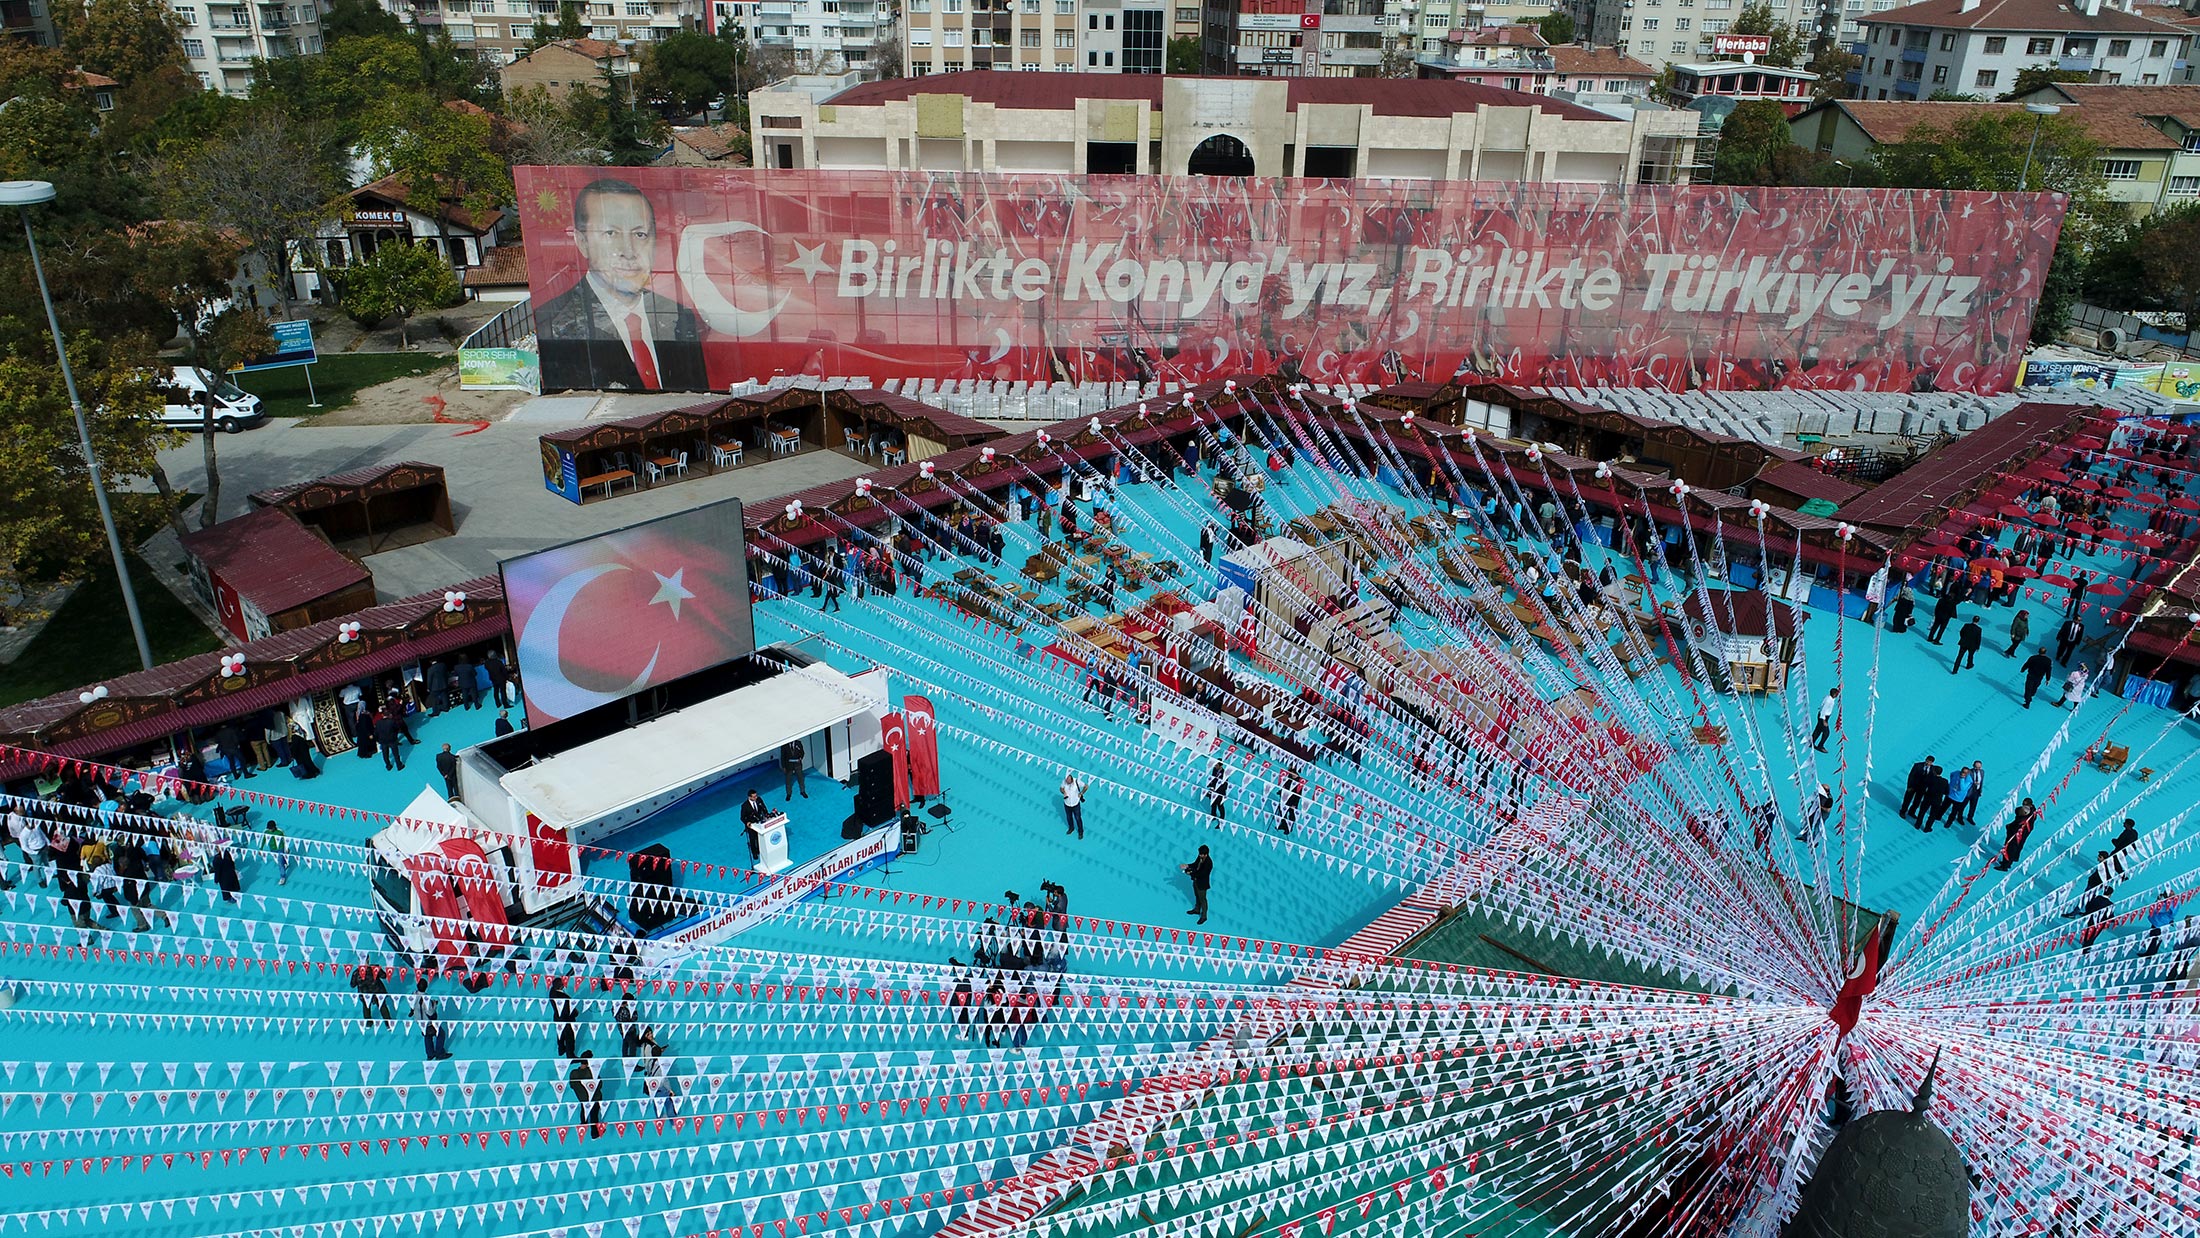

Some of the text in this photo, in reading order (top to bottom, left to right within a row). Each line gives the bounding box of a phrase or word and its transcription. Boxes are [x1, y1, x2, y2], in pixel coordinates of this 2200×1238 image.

[1716, 38, 1767, 50] Merhaba
[355, 211, 391, 220] KOMEK
[837, 238, 1982, 331] Birlikte Konya'yız, Birlikte Türkiye'yiz
[464, 350, 490, 360] SPOR
[464, 360, 497, 368] KONYA
[771, 888, 784, 900] VE
[787, 882, 798, 895] EL
[801, 855, 854, 888] SANATLARI
[856, 840, 884, 861] FUARI
